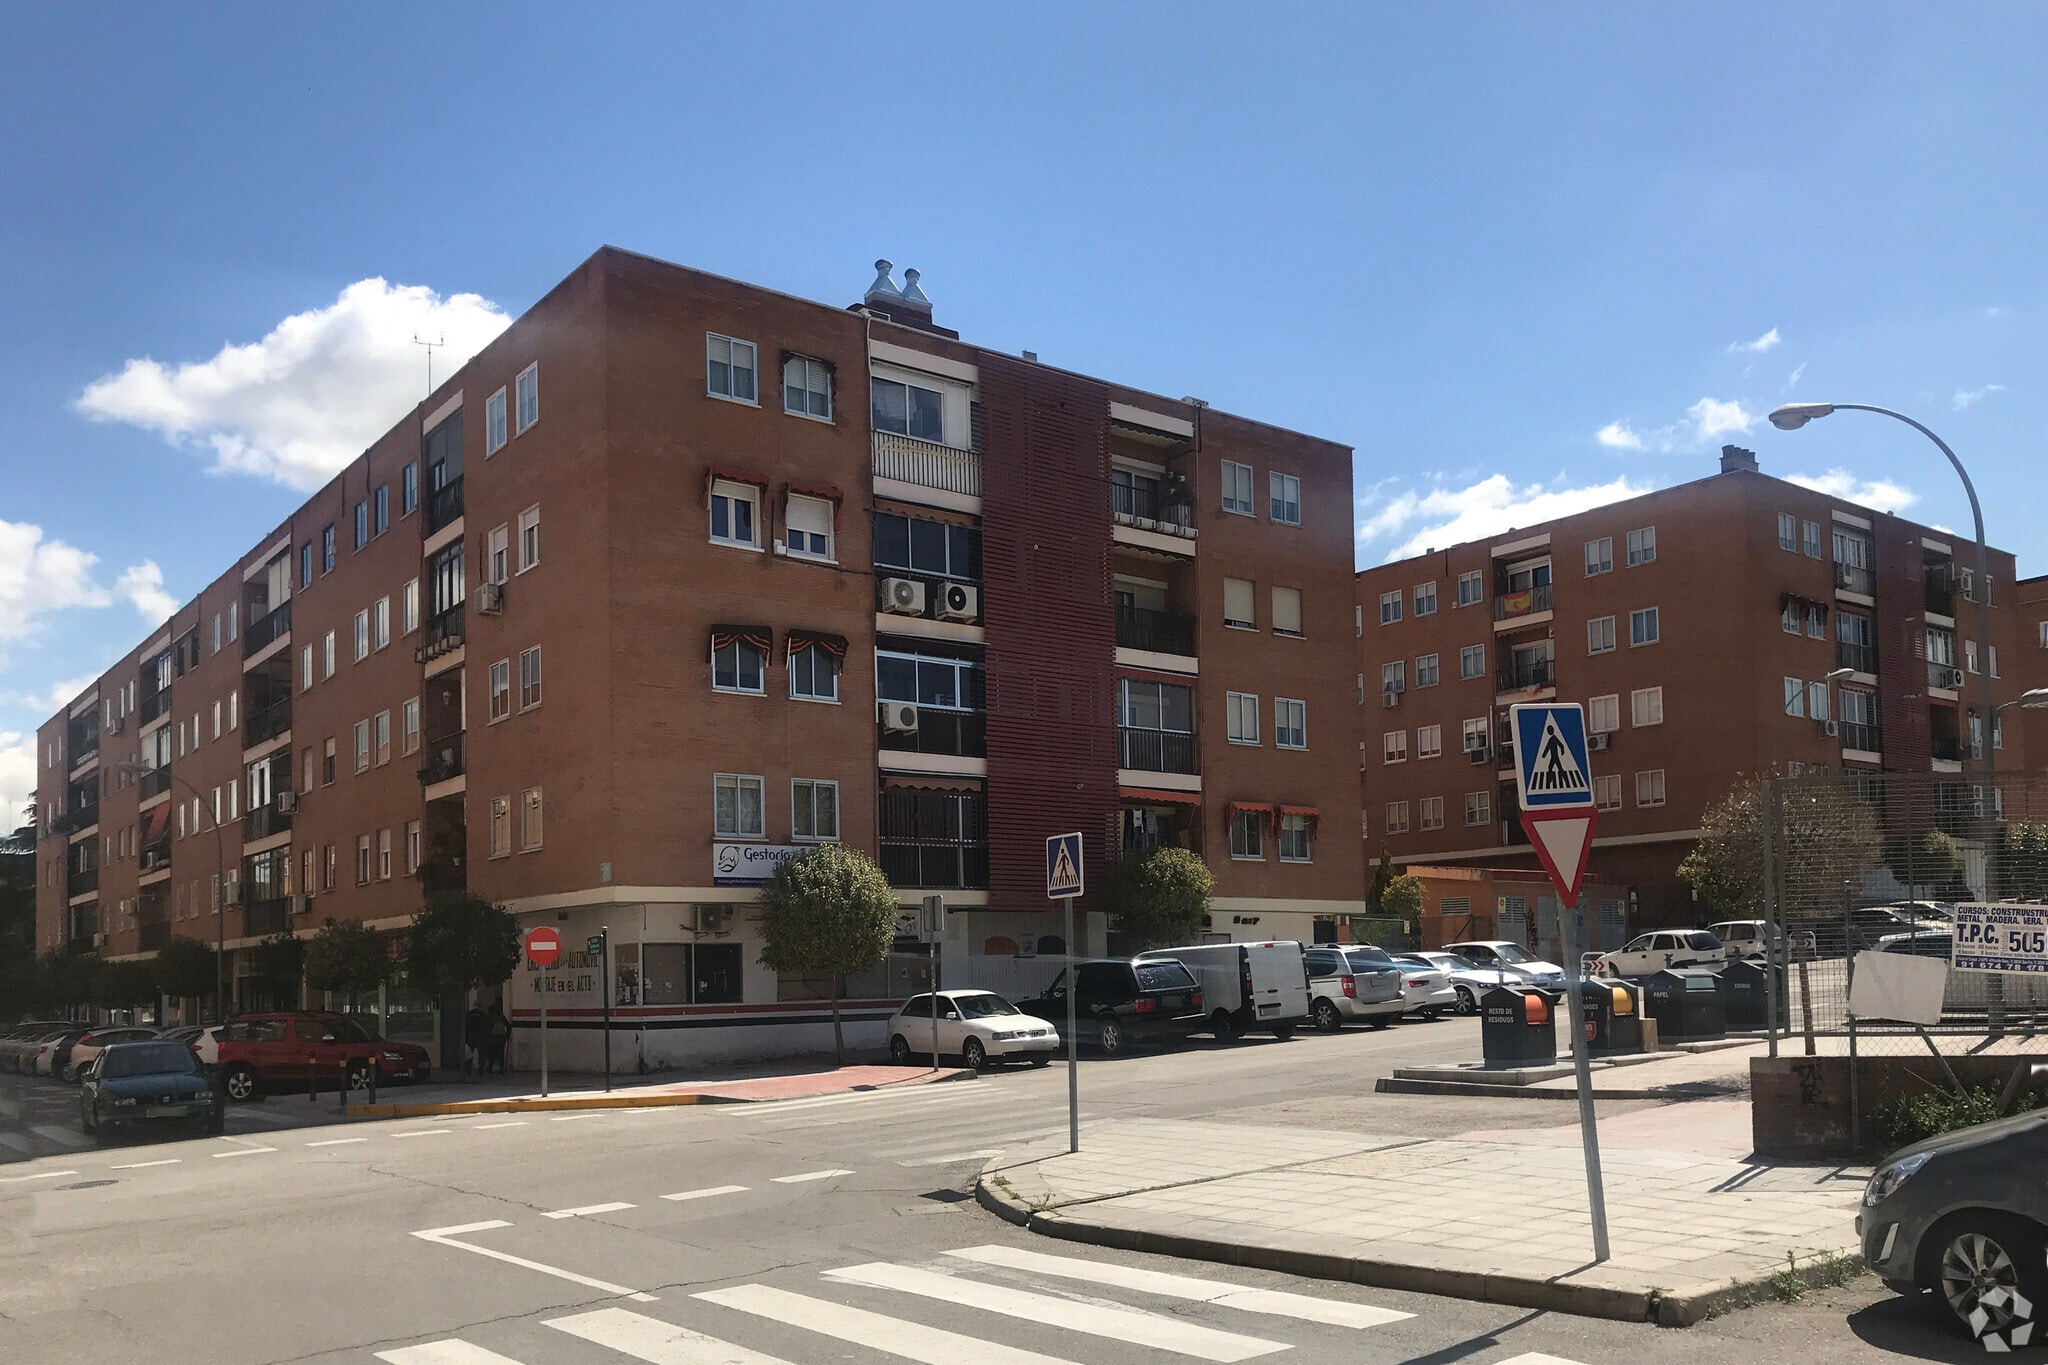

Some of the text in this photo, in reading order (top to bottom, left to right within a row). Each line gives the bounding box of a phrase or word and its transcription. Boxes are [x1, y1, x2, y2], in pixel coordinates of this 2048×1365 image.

[1958, 906, 1990, 915] CURSOS:
[1957, 923, 1999, 944] T.P.C.
[1488, 1007, 1513, 1015] RESTO DE
